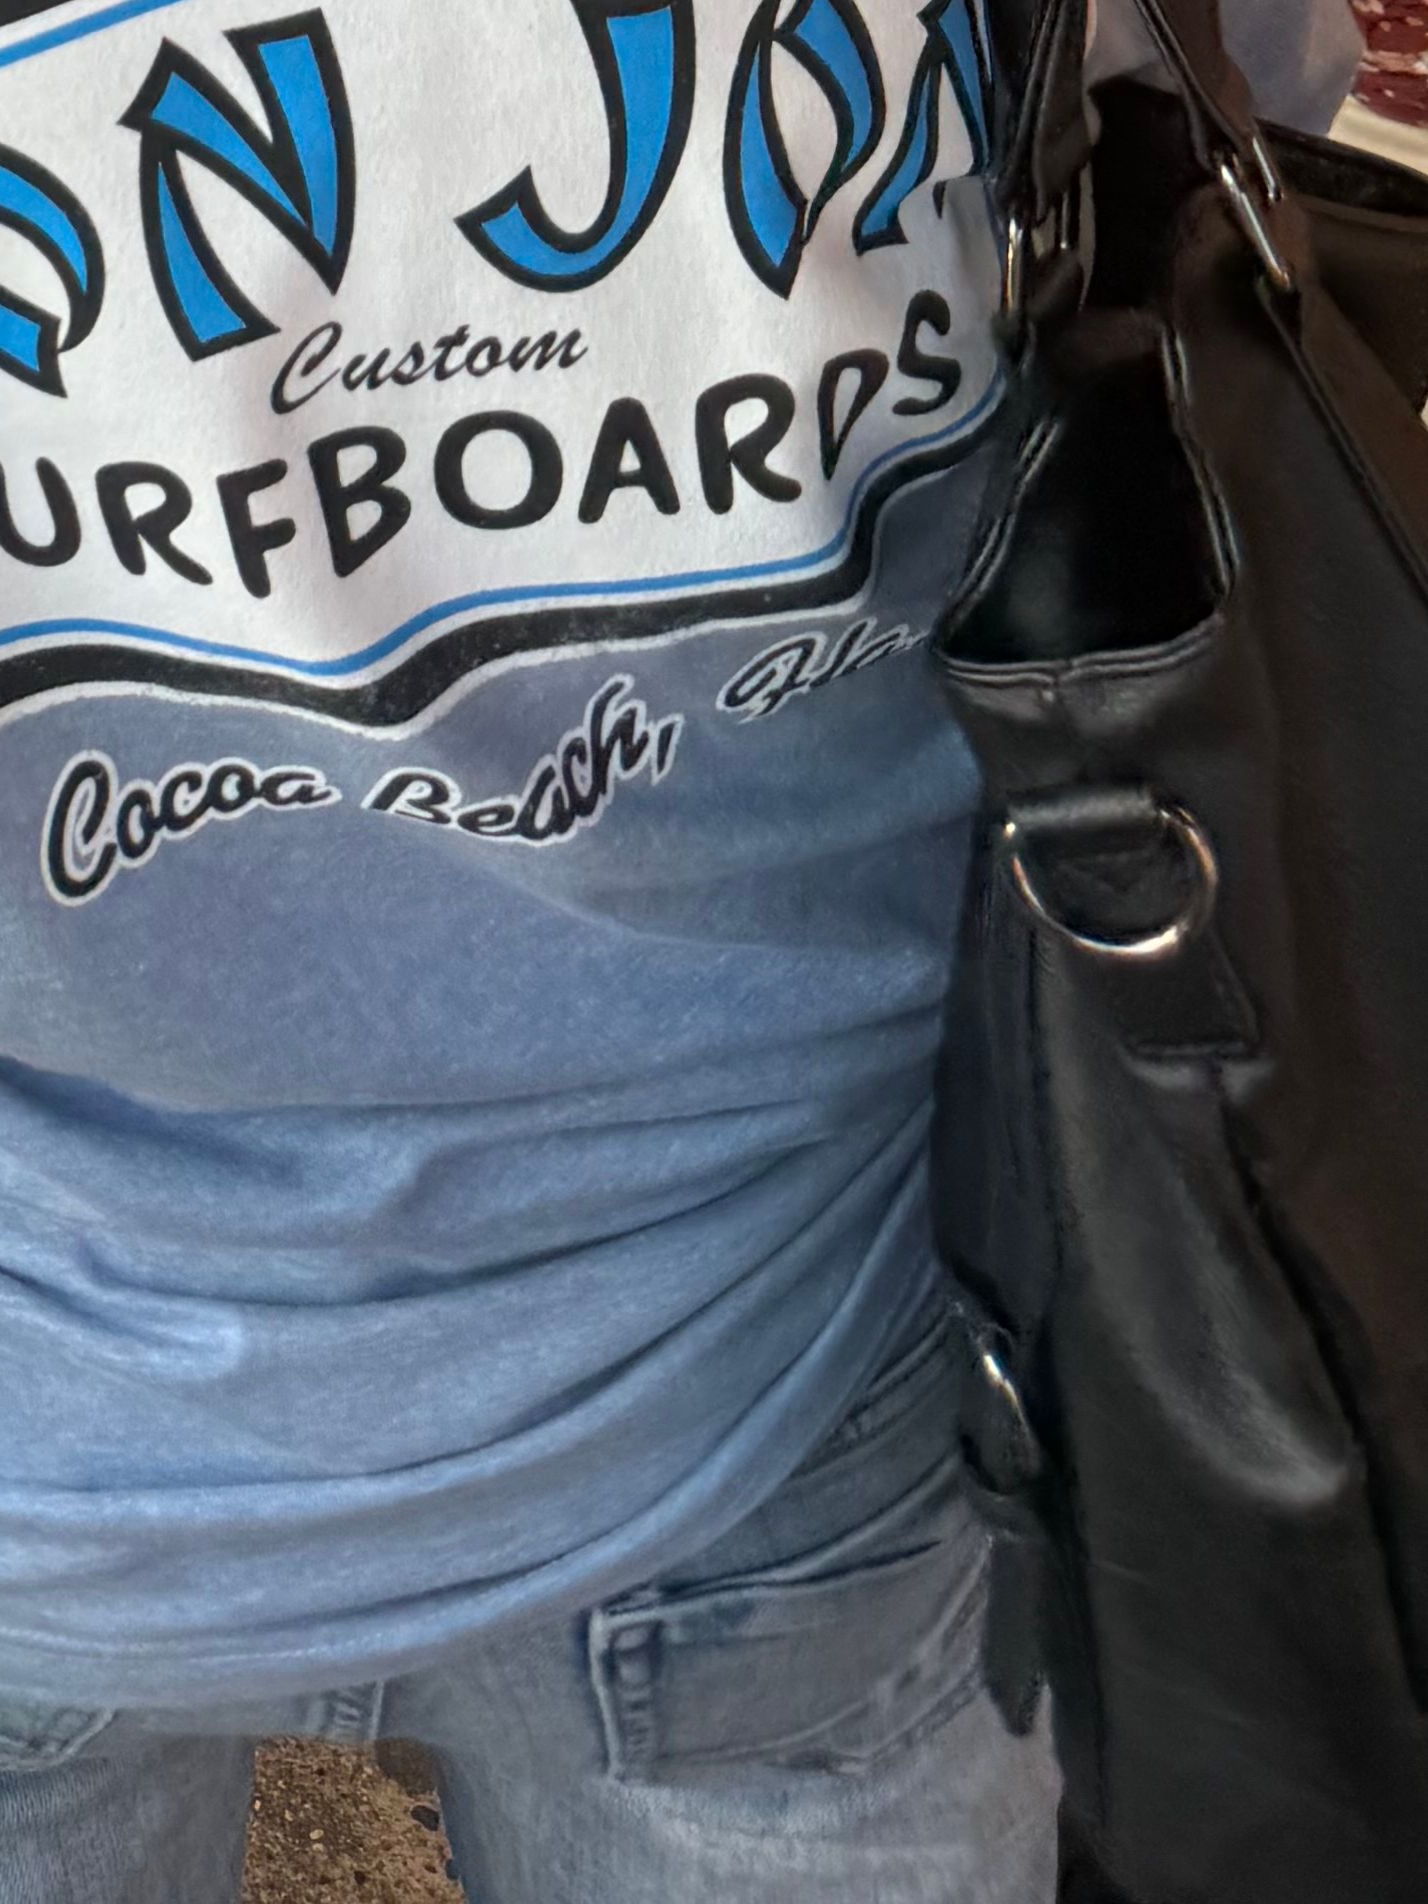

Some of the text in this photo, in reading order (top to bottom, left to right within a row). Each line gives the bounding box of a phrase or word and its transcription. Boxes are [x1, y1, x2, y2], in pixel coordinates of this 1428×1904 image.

[271, 320, 590, 416] Custom
[39, 750, 342, 907] Cocoa
[362, 673, 686, 848] Beach,
